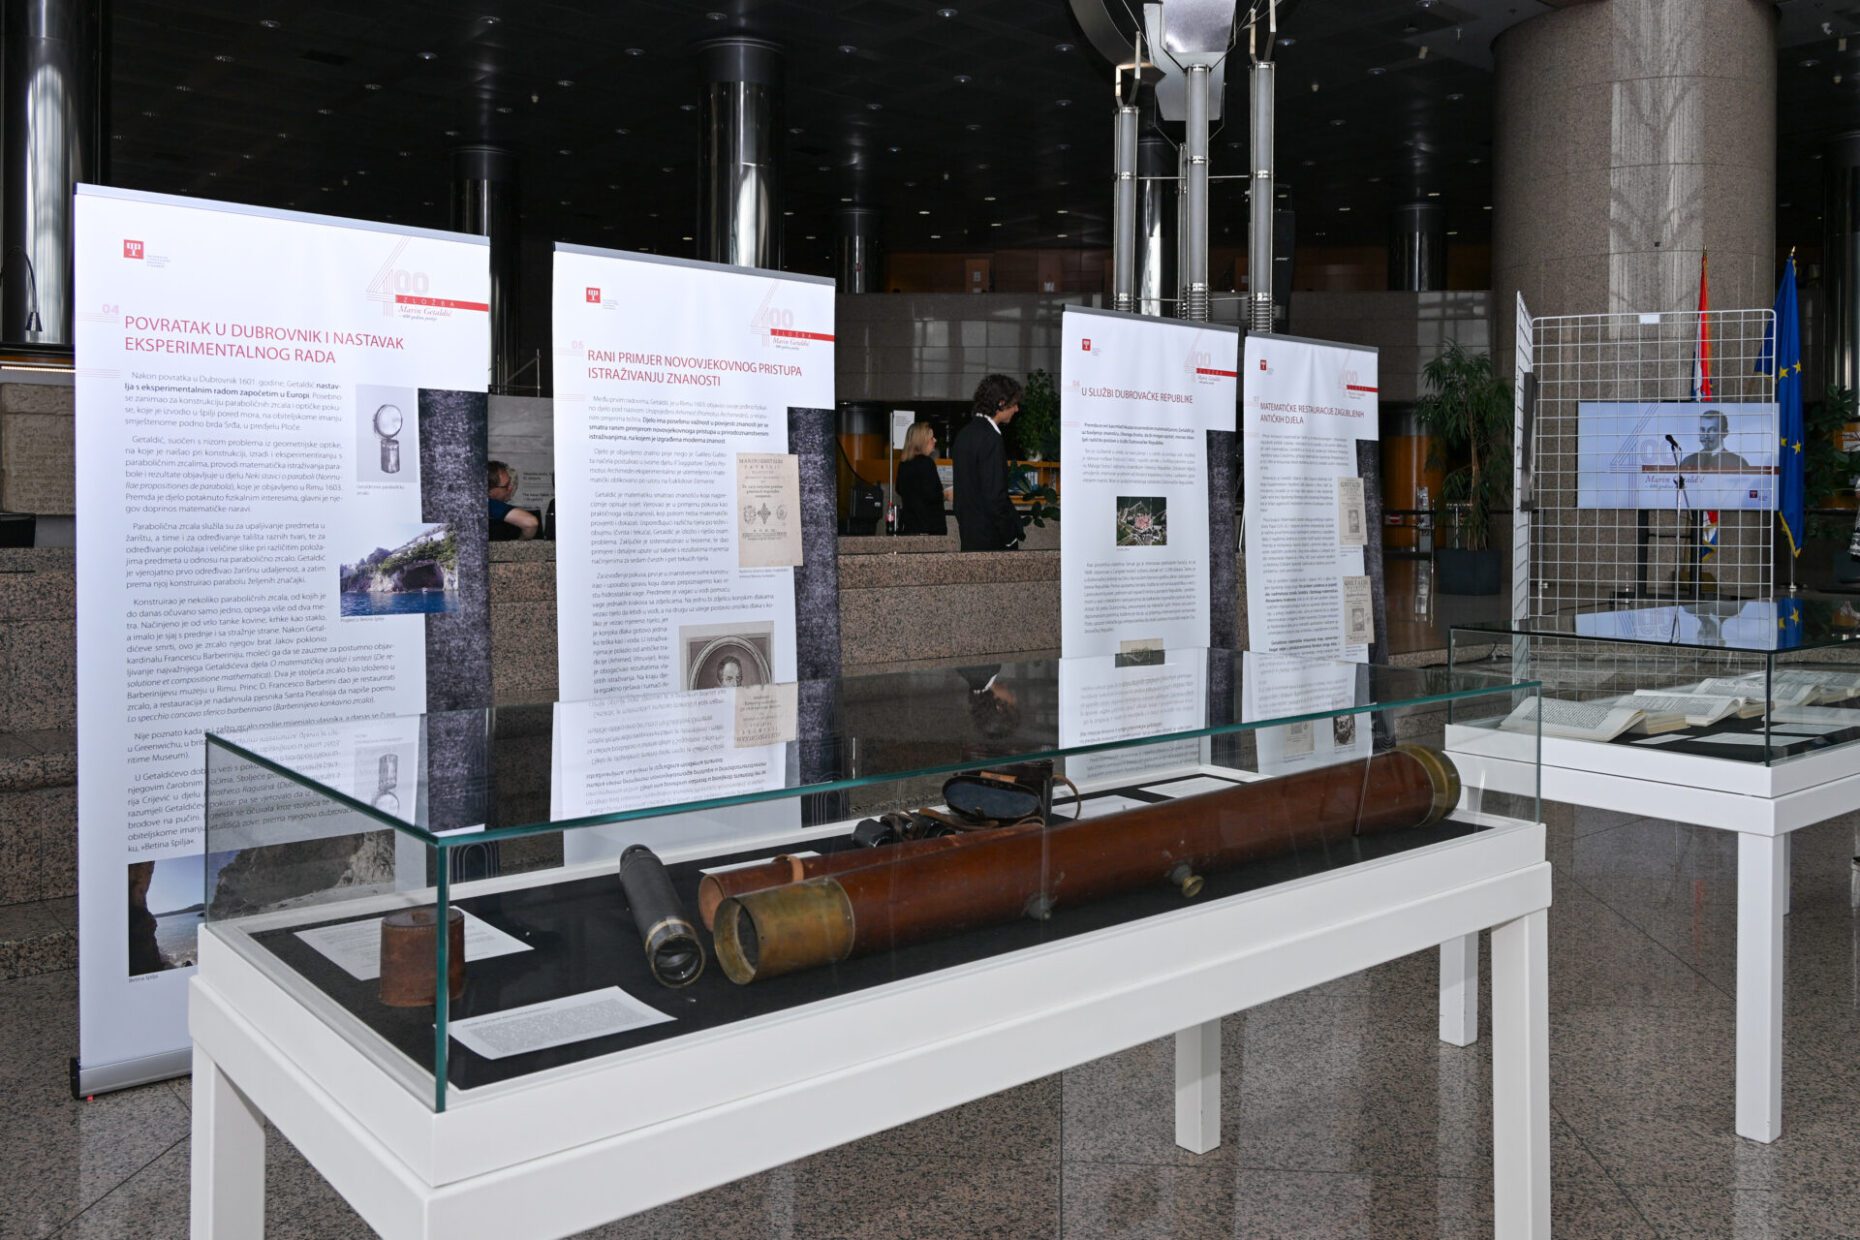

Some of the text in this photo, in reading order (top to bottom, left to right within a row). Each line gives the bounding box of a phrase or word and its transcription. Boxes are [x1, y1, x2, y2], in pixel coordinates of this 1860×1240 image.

[102, 304, 119, 315] 04
[398, 305, 421, 315] Marin
[125, 316, 404, 350] POVRATAK U DUBROVNIK I NASTAVAK
[125, 337, 336, 364] EKSPERIMENTALNOG RADA
[588, 350, 802, 377] RANI PRIMJER NOVOVJEKOVNOG PRISTUPA
[588, 367, 721, 387] ISTRAŽIVANJU ZNANOSTI
[124, 382, 134, 393] lja
[141, 383, 212, 396] eksperimentalnim
[213, 386, 238, 395] radom
[239, 387, 278, 399] započetim
[1082, 386, 1193, 403] U SLUŽBI DUBROVAČKE REPUBLIKE
[1260, 402, 1297, 413] MATEMATIČKE
[1298, 405, 1334, 416] RESTAURACIJE
[1285, 415, 1304, 424] DJELA
[1645, 474, 1671, 484] Marin
